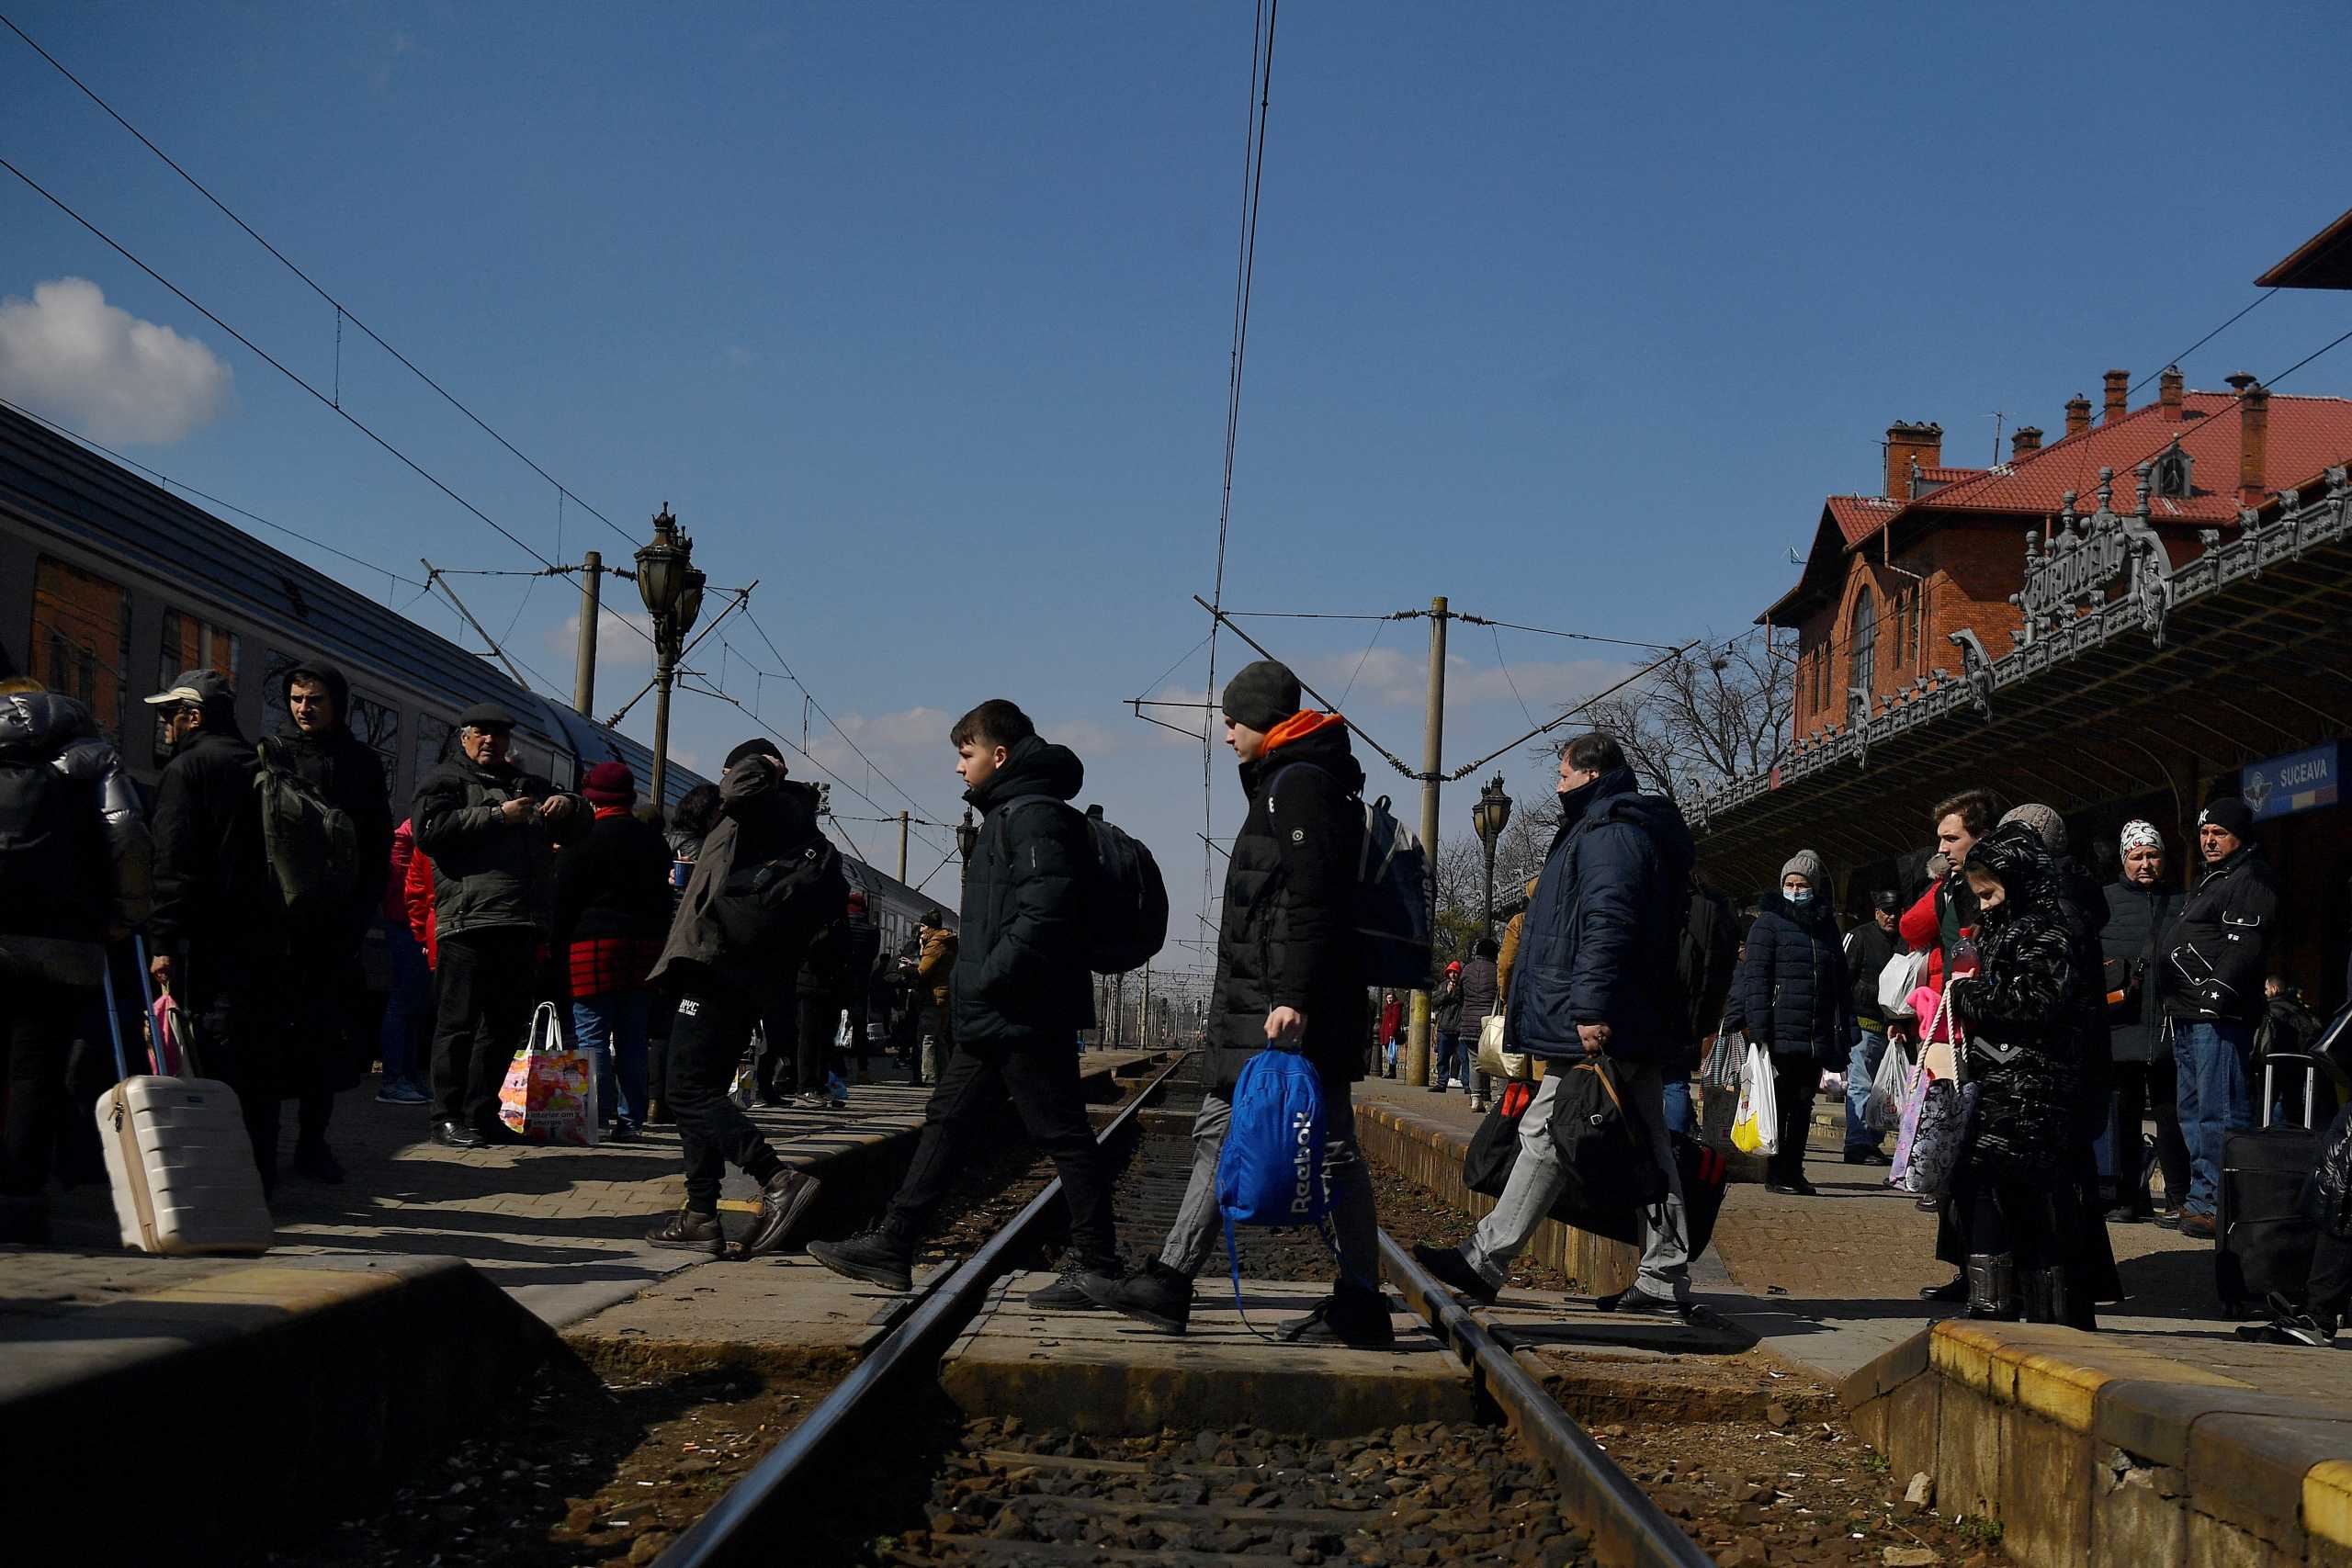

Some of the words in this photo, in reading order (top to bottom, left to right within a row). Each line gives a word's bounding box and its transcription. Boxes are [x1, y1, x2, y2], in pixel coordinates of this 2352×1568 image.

[2280, 759, 2327, 787] SUCEAVA
[680, 998, 700, 1012] NYC
[1290, 1111, 1312, 1213] Reebok
